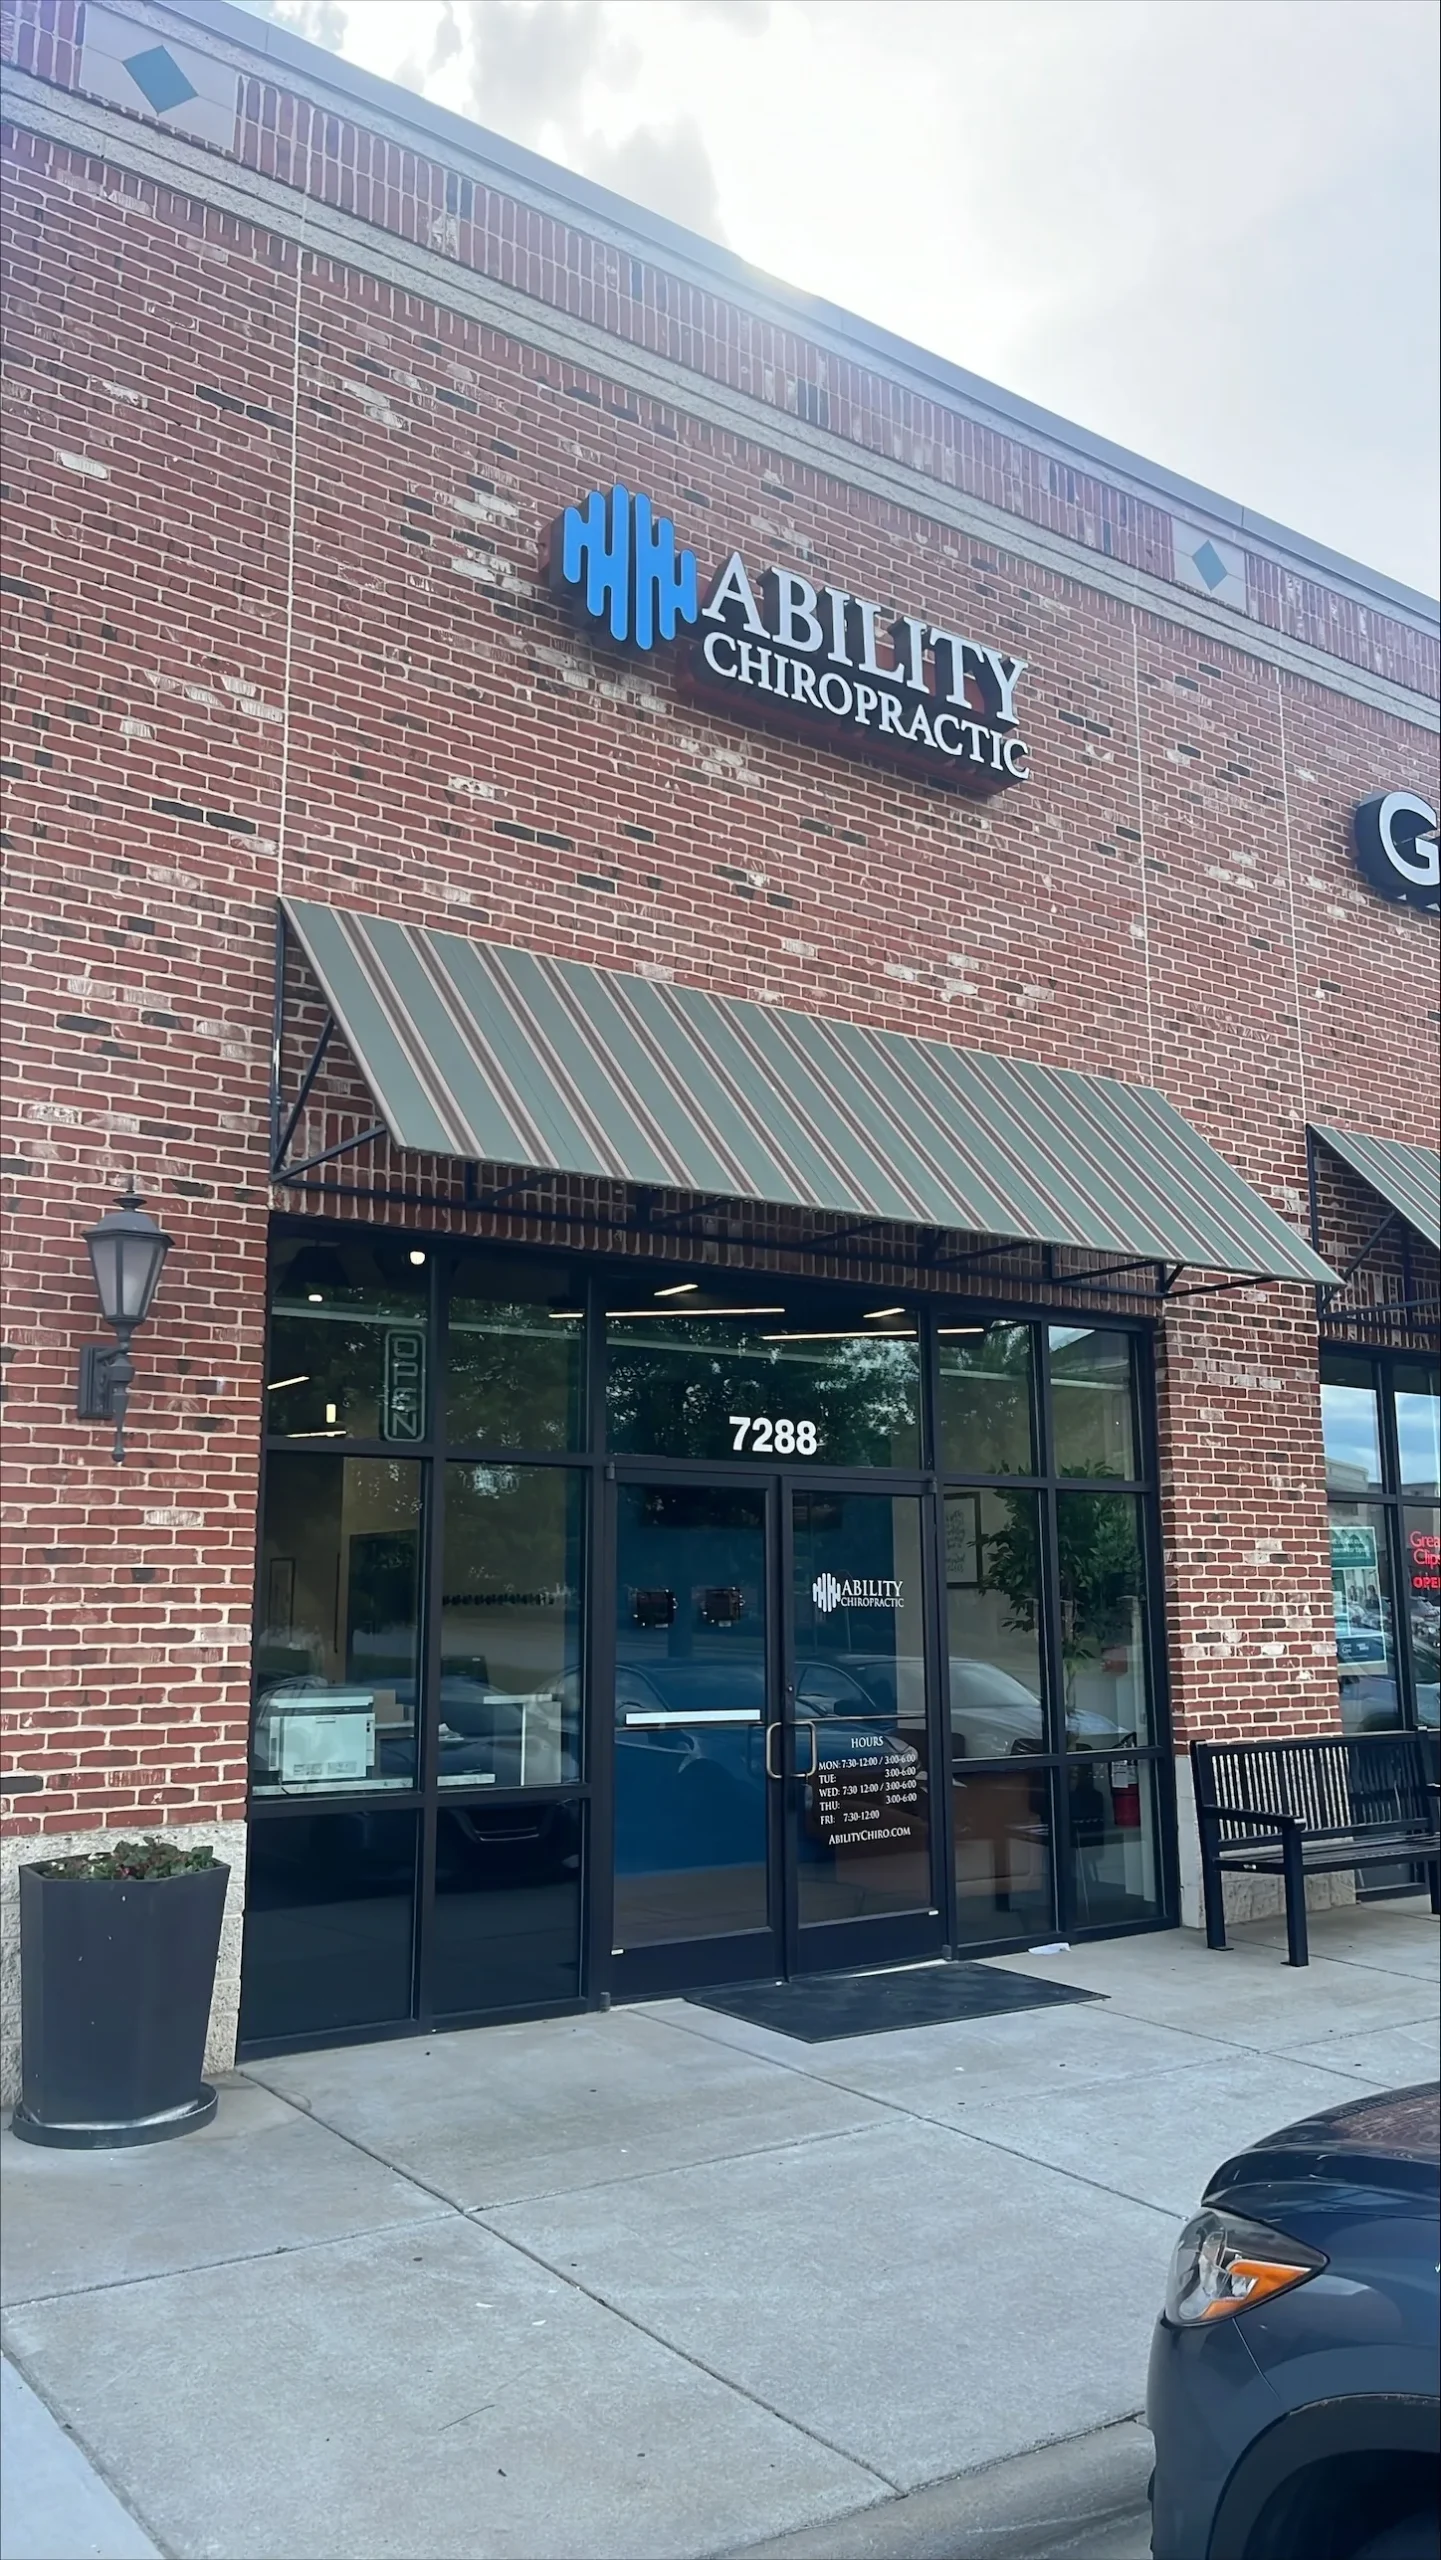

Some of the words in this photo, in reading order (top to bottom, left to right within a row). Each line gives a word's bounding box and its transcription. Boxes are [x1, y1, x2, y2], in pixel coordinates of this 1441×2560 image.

[702, 551, 1028, 725] ABILITY
[703, 632, 1030, 779] CHIROPRACTIC
[1379, 791, 1440, 886] G
[393, 1337, 418, 1436] OPEN
[729, 1416, 817, 1455] 7288
[841, 1579, 903, 1597] ABILITY
[1413, 1576, 1440, 1589] OPE
[840, 1597, 904, 1608] CHIROPRACTIC
[851, 1736, 884, 1749] HOURS
[818, 1761, 841, 1771] MON:
[841, 1757, 878, 1769] 7:30-12:00
[884, 1754, 916, 1765] 3:00-6:00
[818, 1774, 837, 1784] TUE:
[884, 1766, 916, 1778] 3:00-6:00
[819, 1787, 840, 1798] WED:
[885, 1779, 917, 1791] 3:00-6:00
[819, 1801, 840, 1811] THU:
[886, 1793, 917, 1804] 3:00-6:00
[820, 1815, 836, 1825] FRI:
[844, 1810, 880, 1822] 7:30-12:00
